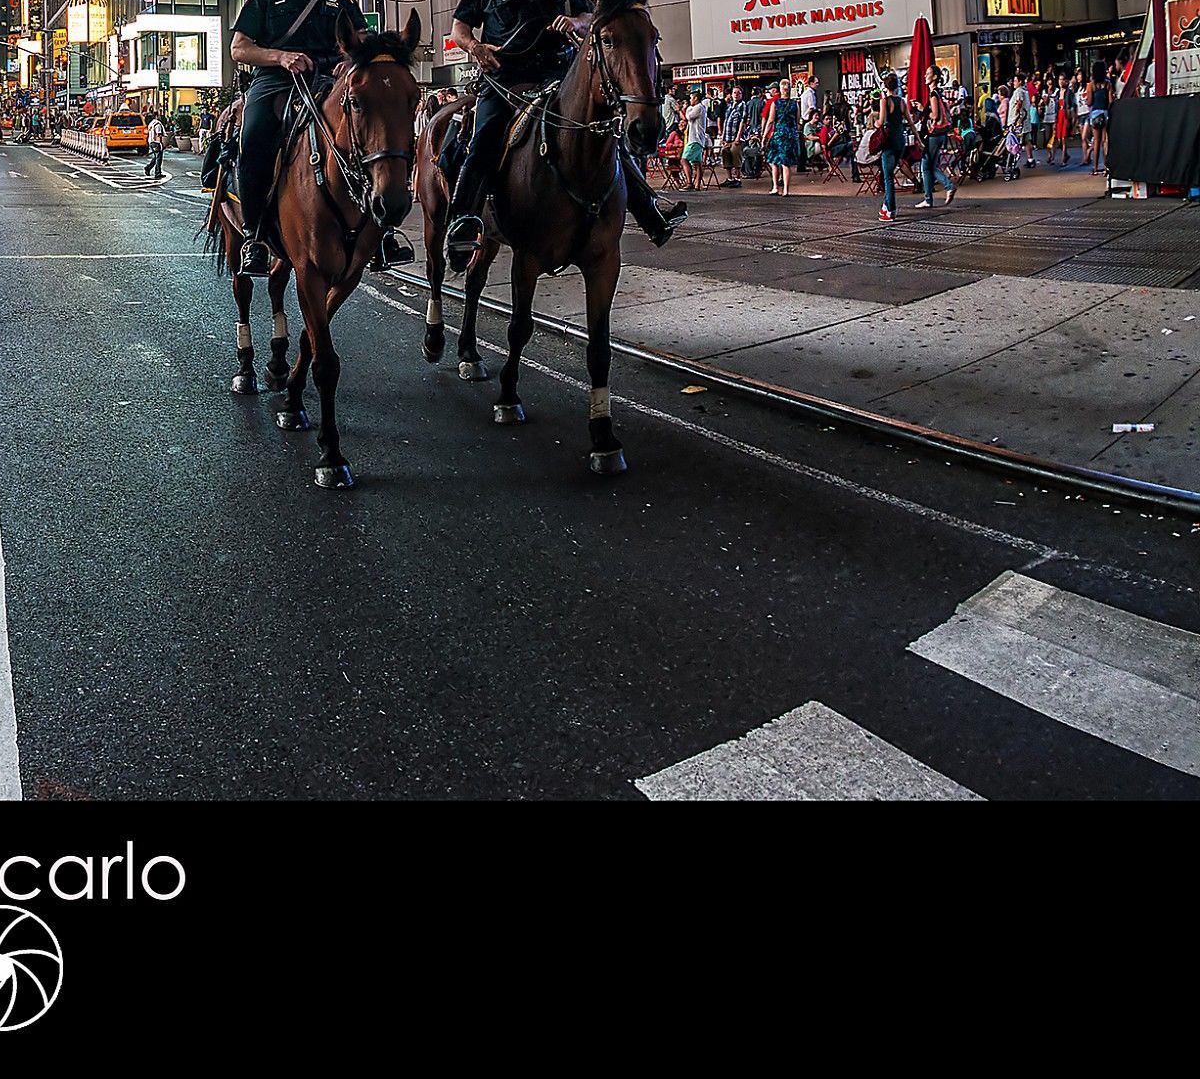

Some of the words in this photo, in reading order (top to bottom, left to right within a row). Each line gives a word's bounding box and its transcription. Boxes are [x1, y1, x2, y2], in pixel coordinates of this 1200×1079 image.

[730, 17, 763, 34] NEW
[765, 10, 807, 29] YORK
[810, 0, 885, 23] MARQUIS
[673, 66, 681, 78] THE
[841, 51, 865, 74] EVITA
[865, 57, 874, 72] IS
[841, 75, 847, 90] A
[848, 74, 862, 90] BIG,
[862, 72, 876, 89] FAT,
